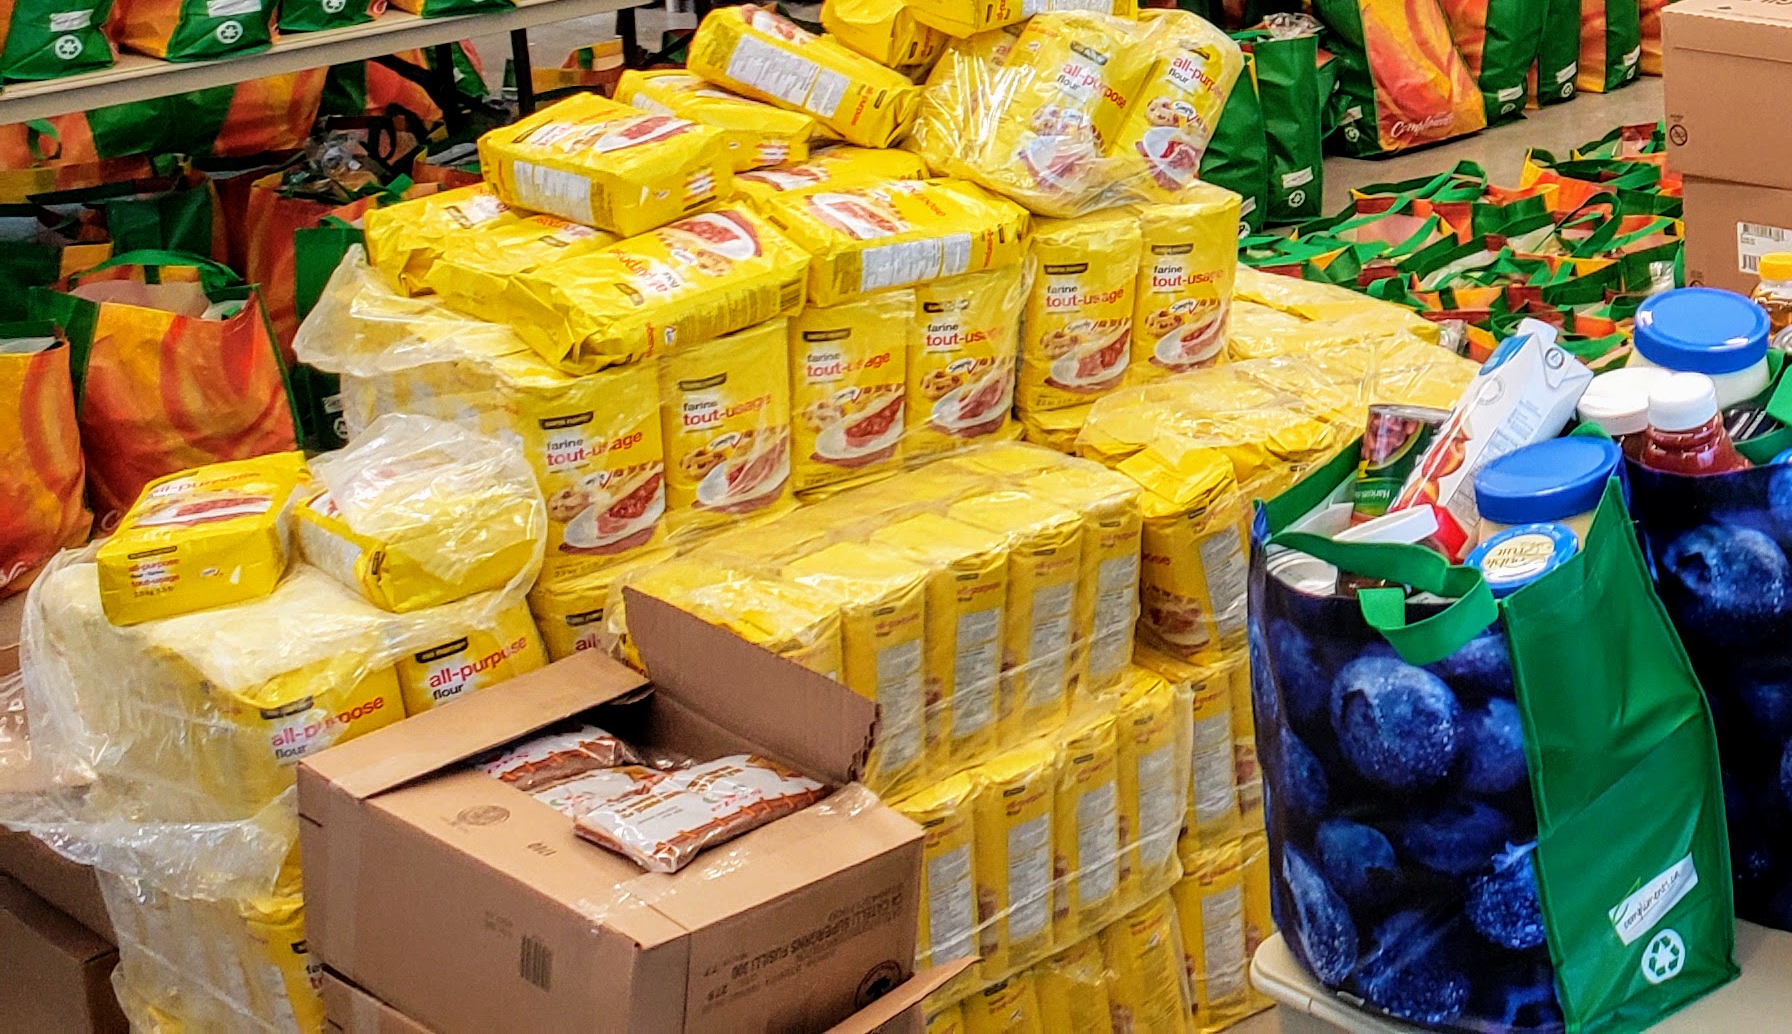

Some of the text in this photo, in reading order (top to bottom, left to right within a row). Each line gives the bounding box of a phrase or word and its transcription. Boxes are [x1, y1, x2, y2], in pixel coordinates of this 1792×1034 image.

[1056, 73, 1082, 92] flour
[1168, 67, 1190, 85] flour
[1153, 264, 1183, 275] farine
[1045, 288, 1125, 309] tout-usage
[1046, 284, 1078, 295] farine
[927, 322, 959, 334] farine
[806, 351, 841, 364] farine
[683, 398, 719, 412] farine
[683, 394, 772, 427] tout-usage
[546, 437, 584, 452] farine
[429, 635, 528, 689] all-purpose
[433, 682, 464, 701] flour
[275, 743, 308, 761] flour
